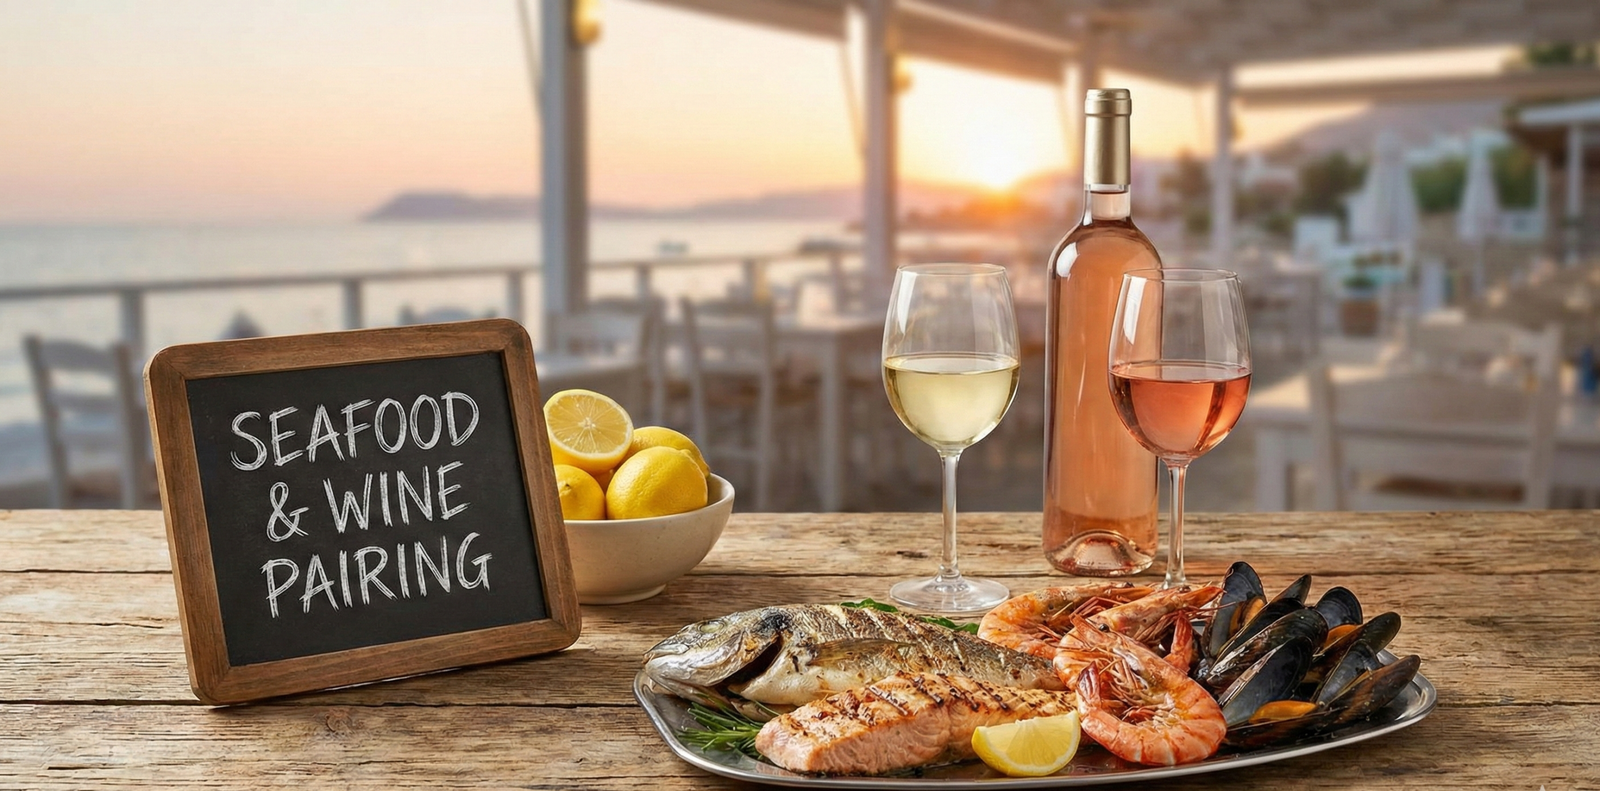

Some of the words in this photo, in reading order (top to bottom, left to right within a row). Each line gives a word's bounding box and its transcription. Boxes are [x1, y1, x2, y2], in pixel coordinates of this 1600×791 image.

[230, 391, 480, 471] SEAFOOD
[266, 481, 309, 542] &
[322, 460, 471, 534] WINE
[260, 531, 493, 619] PAIRING
